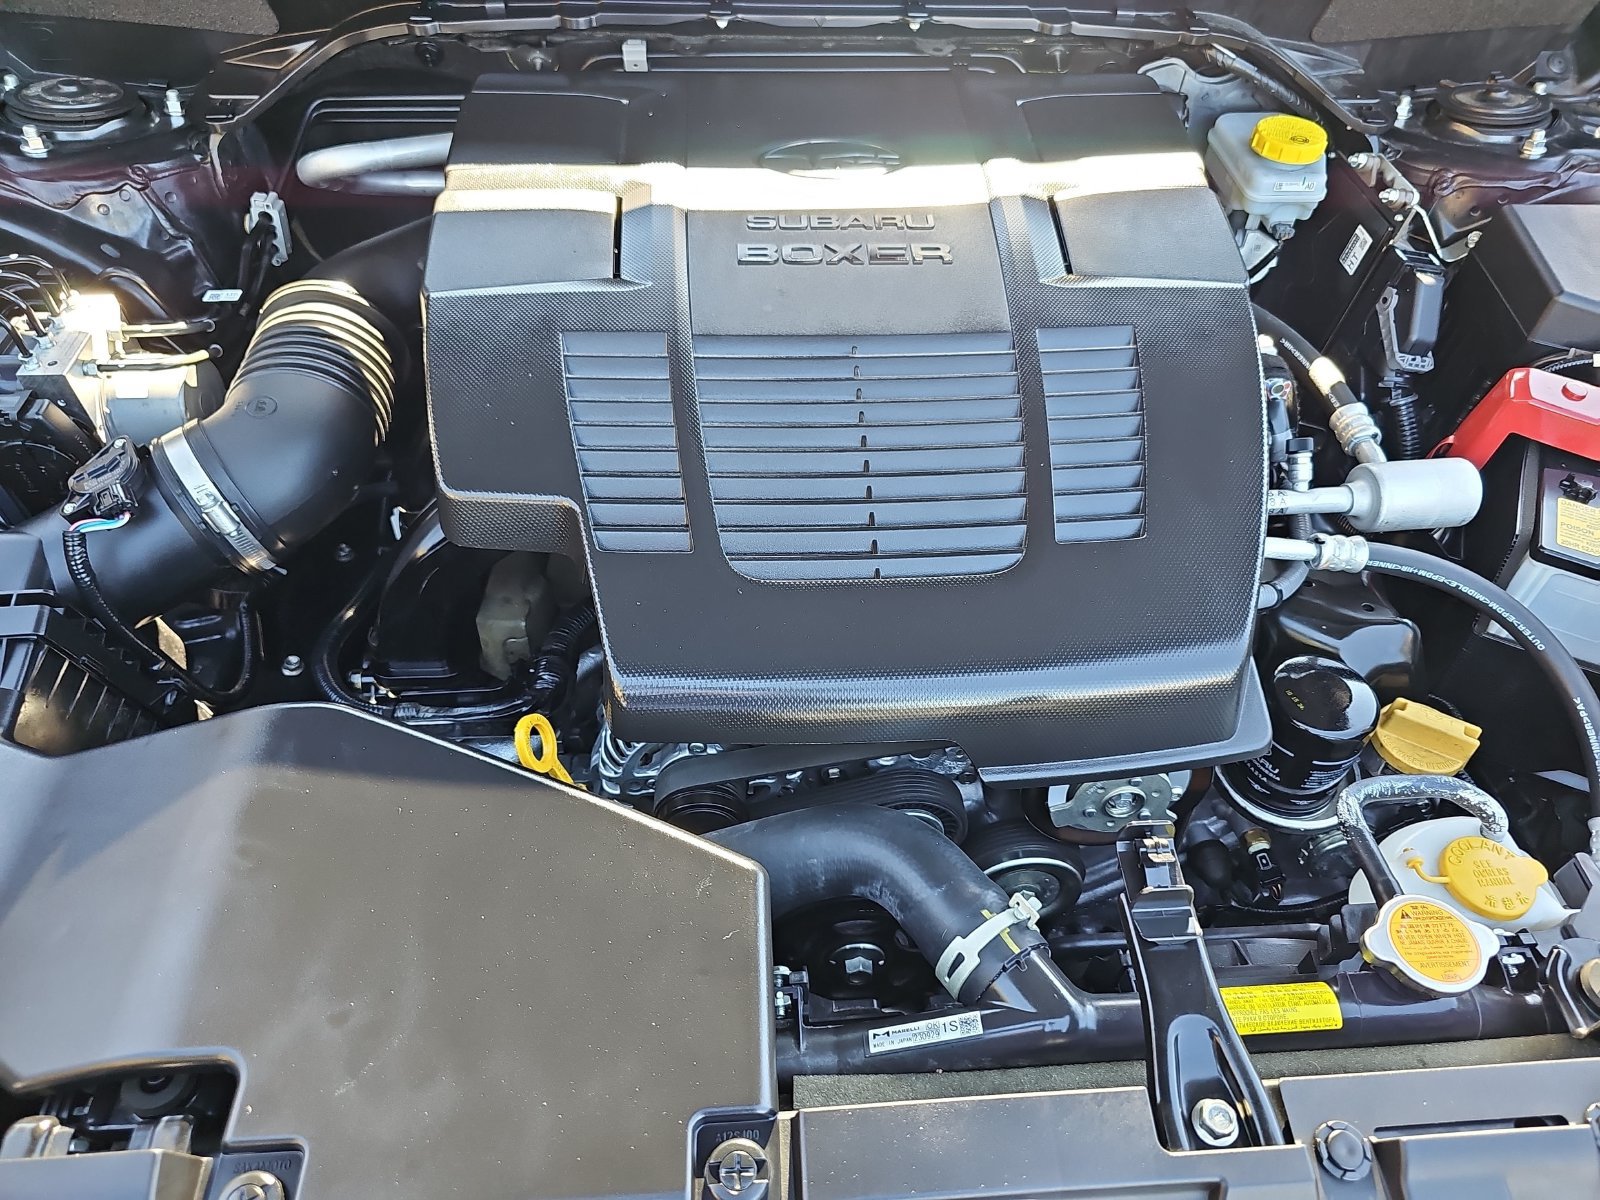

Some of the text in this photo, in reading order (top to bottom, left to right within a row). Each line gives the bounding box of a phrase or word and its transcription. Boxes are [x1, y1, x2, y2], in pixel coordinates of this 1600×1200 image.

[746, 214, 936, 231] SUBARU
[736, 243, 953, 265] BOXER
[1561, 521, 1594, 536] POISON
[1448, 839, 1515, 866] COOLANT
[1473, 860, 1492, 870] SEE
[942, 1020, 958, 1032] 1S
